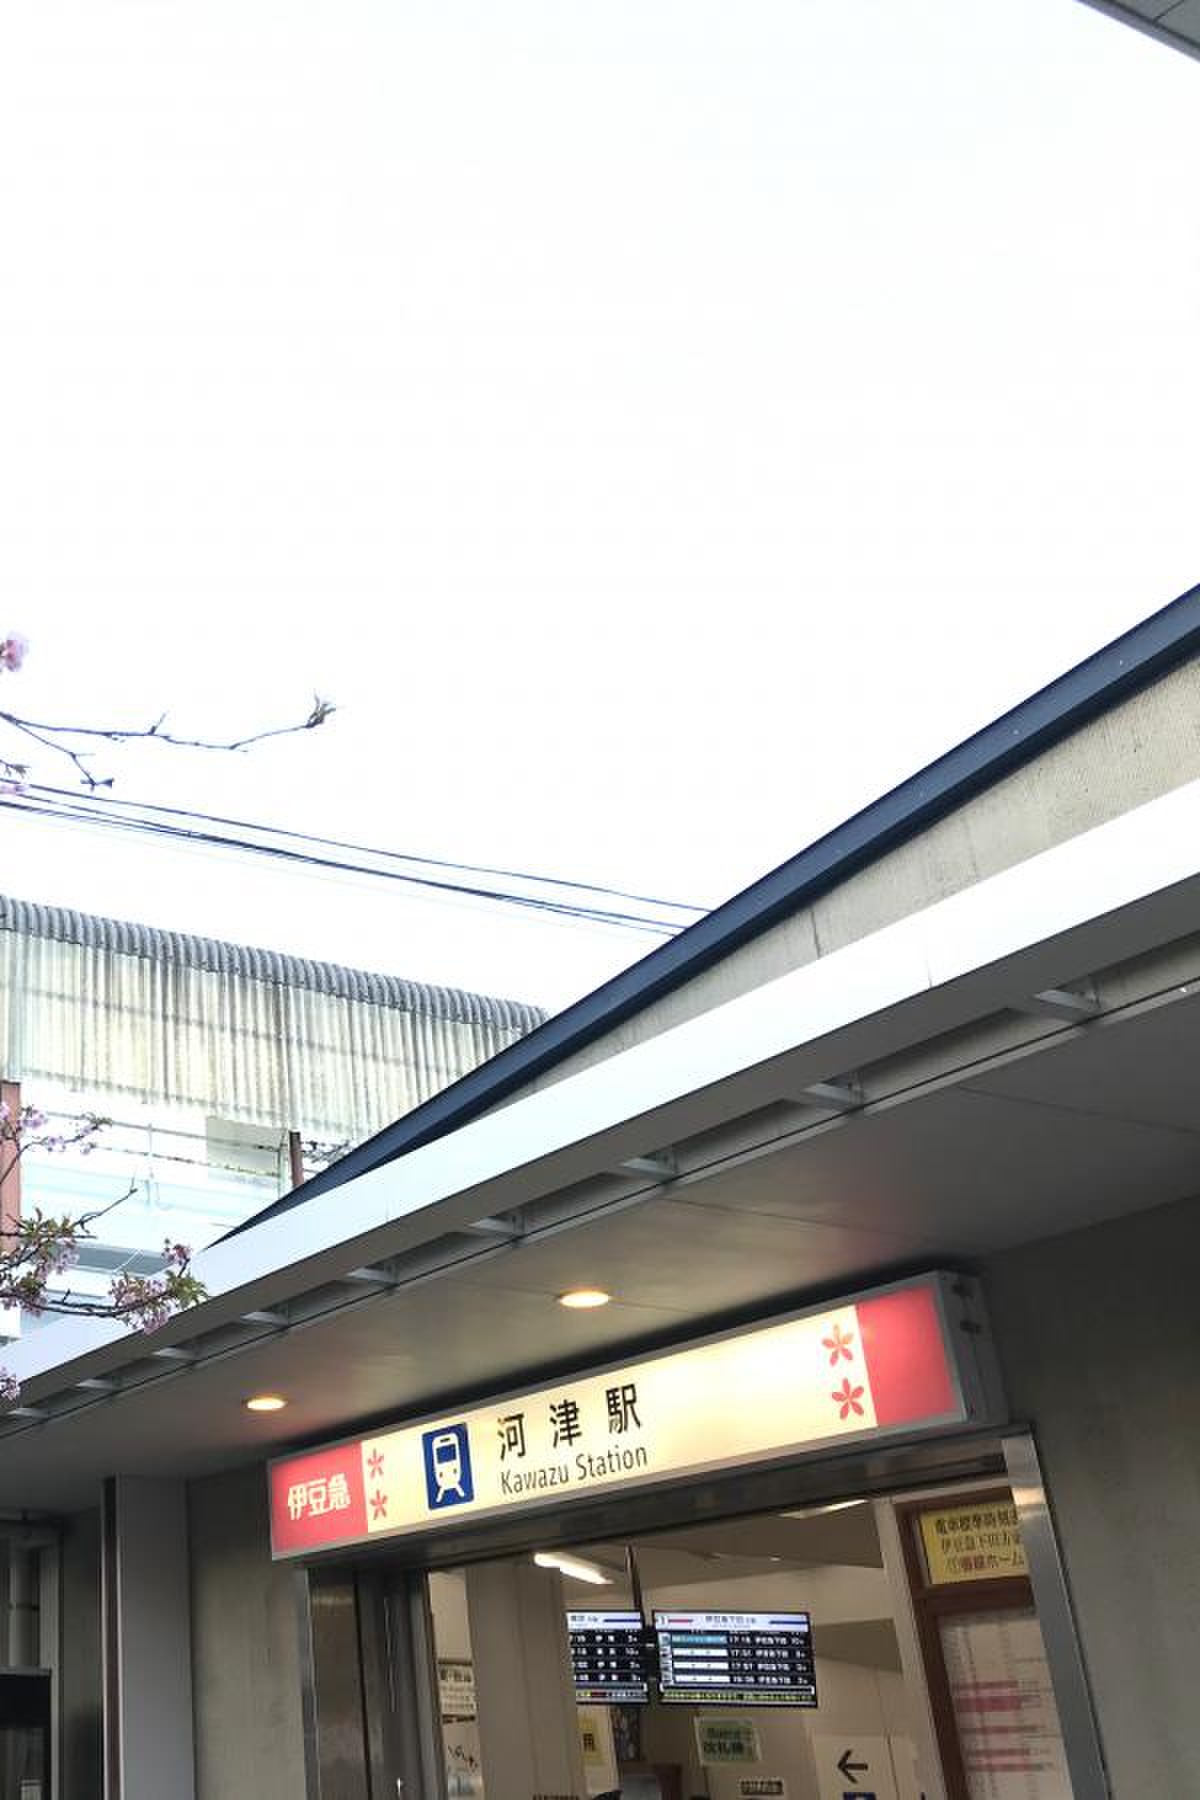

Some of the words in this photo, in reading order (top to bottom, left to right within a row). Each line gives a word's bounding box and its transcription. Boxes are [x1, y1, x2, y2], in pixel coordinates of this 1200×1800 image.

[497, 1383, 641, 1461] 河津駅
[501, 1462, 569, 1495] Kawazu
[575, 1446, 648, 1481] Station
[287, 1473, 350, 1520] 伊豆急
